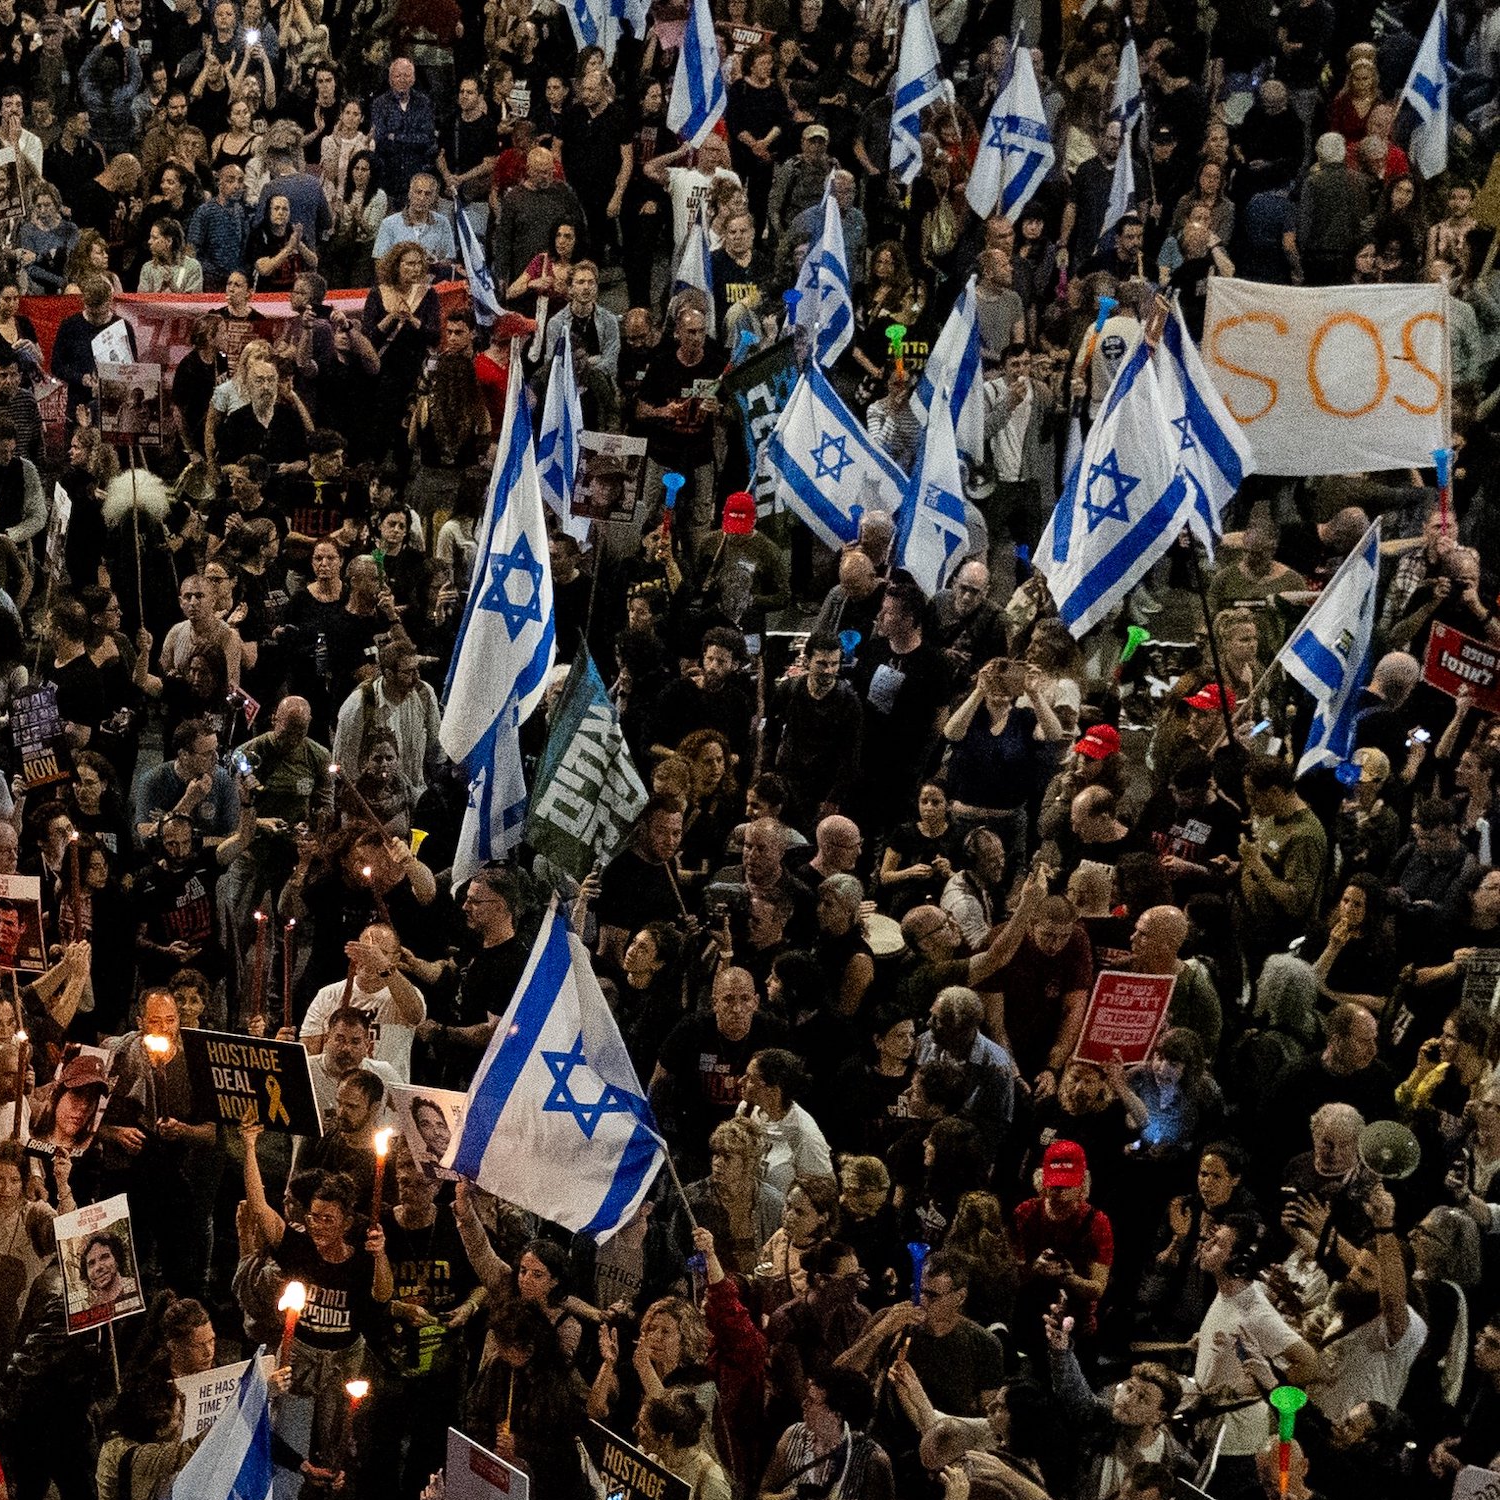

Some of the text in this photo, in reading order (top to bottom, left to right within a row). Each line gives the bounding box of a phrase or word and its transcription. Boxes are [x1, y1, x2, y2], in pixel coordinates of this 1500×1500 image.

[1210, 311, 1445, 424] SOS
[22, 755, 60, 783] NOW
[205, 1040, 282, 1073] HOSTAGE
[210, 1066, 256, 1095] DEAL
[216, 1093, 260, 1122] NOW
[27, 1138, 57, 1155] BRING
[199, 1378, 236, 1399] HE HAS
[198, 1400, 221, 1415] TIME
